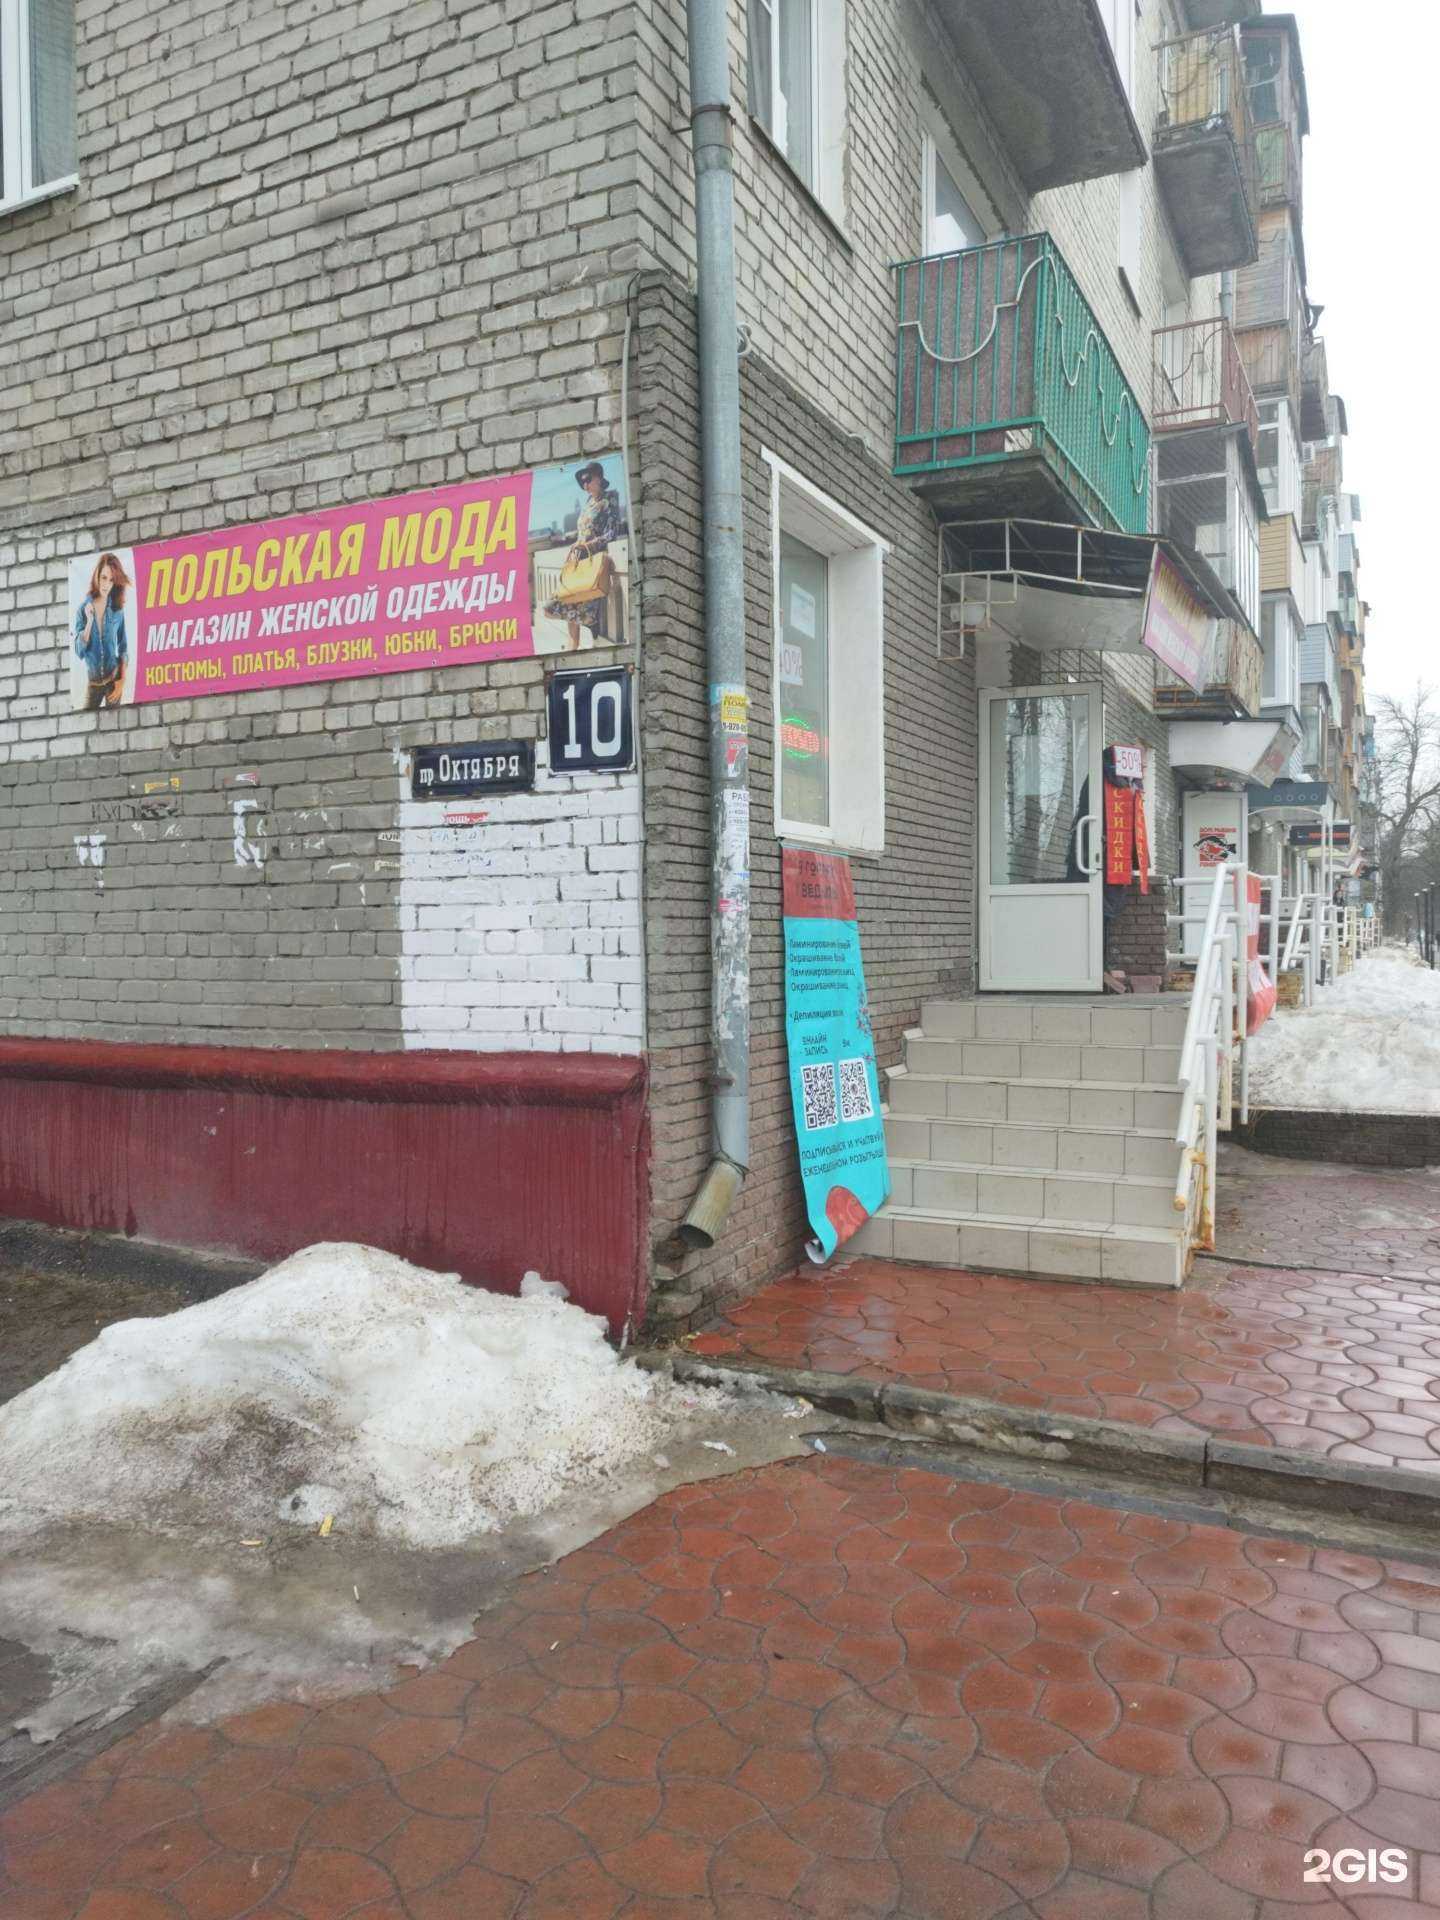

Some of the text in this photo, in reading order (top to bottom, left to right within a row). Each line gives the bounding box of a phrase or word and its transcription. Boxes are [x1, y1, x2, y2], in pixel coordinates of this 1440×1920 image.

[146, 496, 516, 608] ПОЛЬСКАЯ МОДА
[145, 618, 518, 686] КОСТЮМЫ, ПЛАТЬЯ, БЛУЗКИ, ЮБКИ, БРЮКИ
[146, 570, 517, 653] МАГАЗИН ЖЕНСКОЙ ОДЕЖДЫ
[563, 680, 622, 759] 10
[1113, 788, 1124, 874] СКИДКИ
